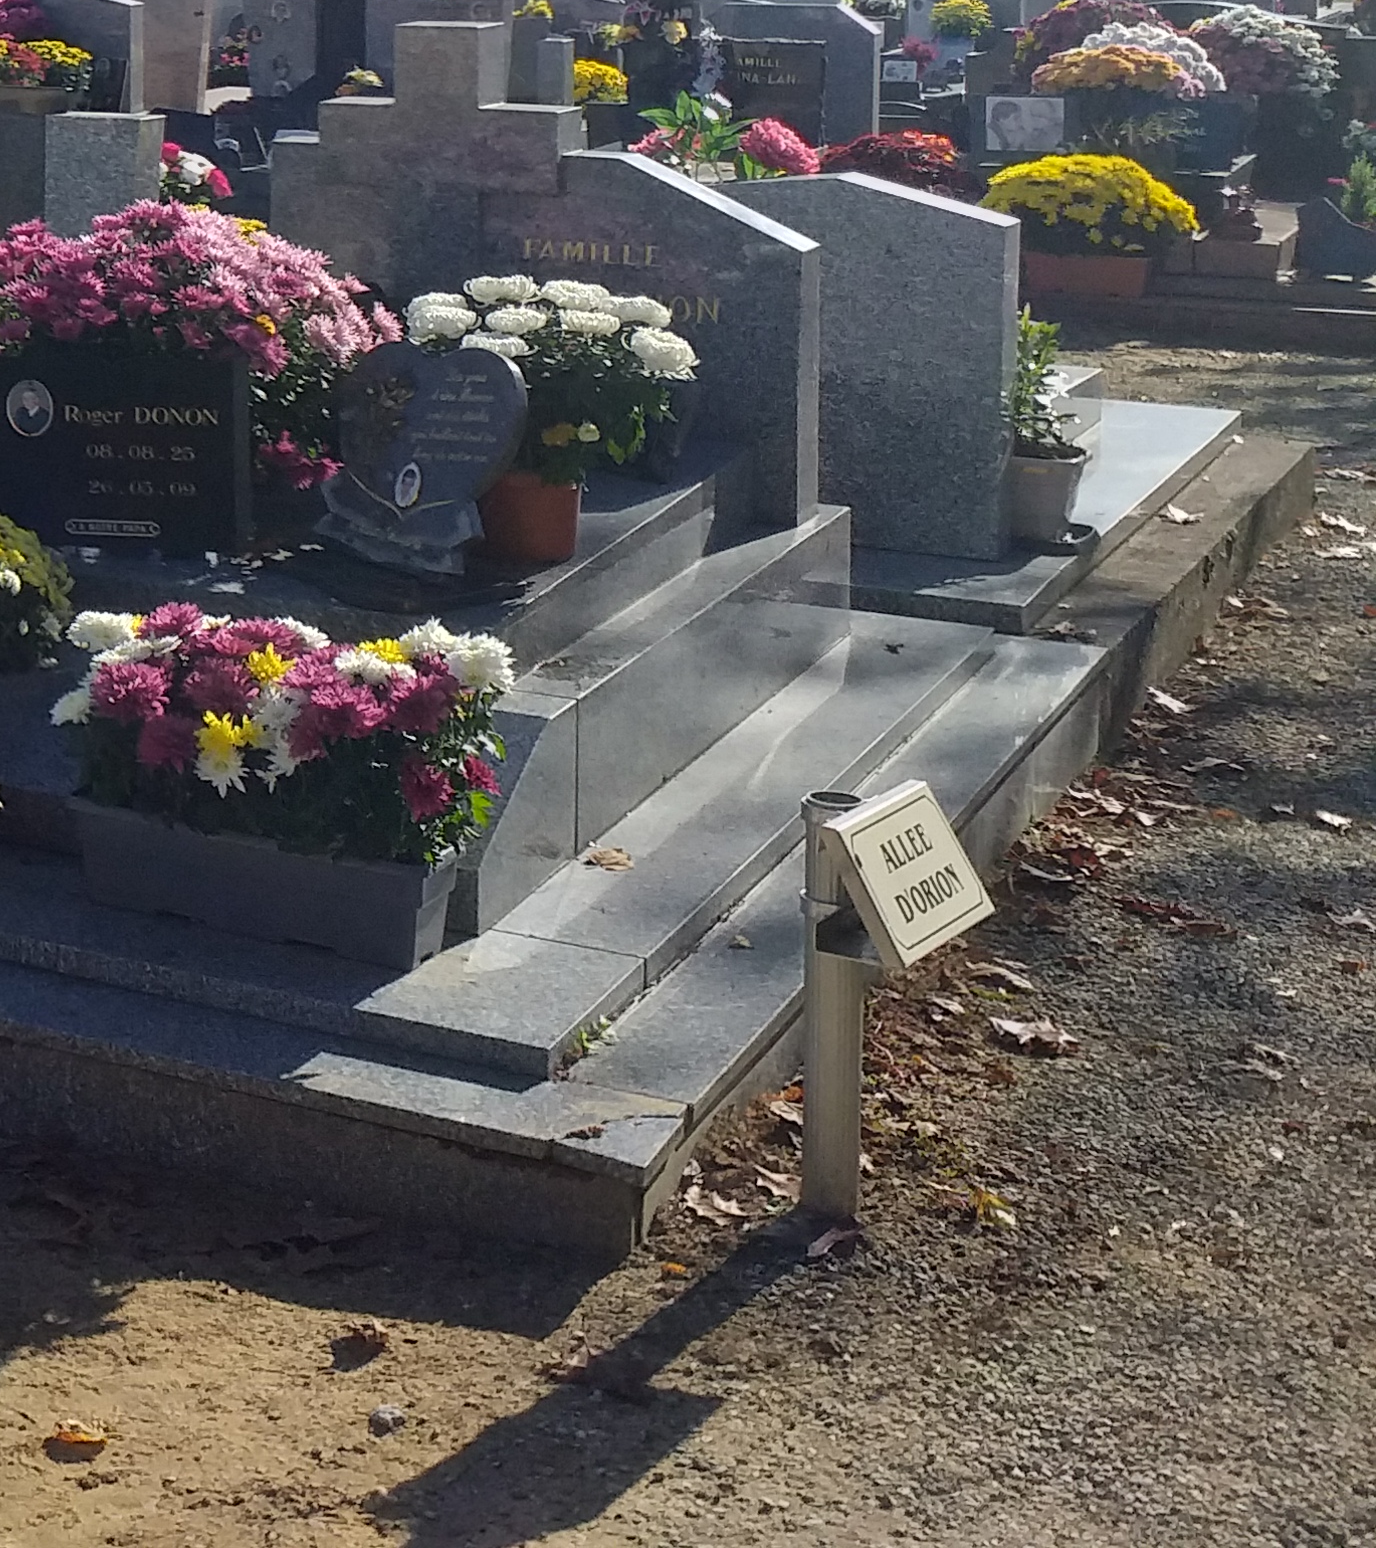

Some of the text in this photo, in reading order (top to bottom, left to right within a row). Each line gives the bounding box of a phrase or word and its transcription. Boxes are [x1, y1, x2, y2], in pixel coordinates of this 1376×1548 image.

[737, 57, 782, 68] AMILLE
[523, 238, 662, 268] FAMILLE
[64, 405, 219, 426] Roger DONON
[880, 823, 933, 873] ALLEE
[894, 864, 964, 923] D'ORION
